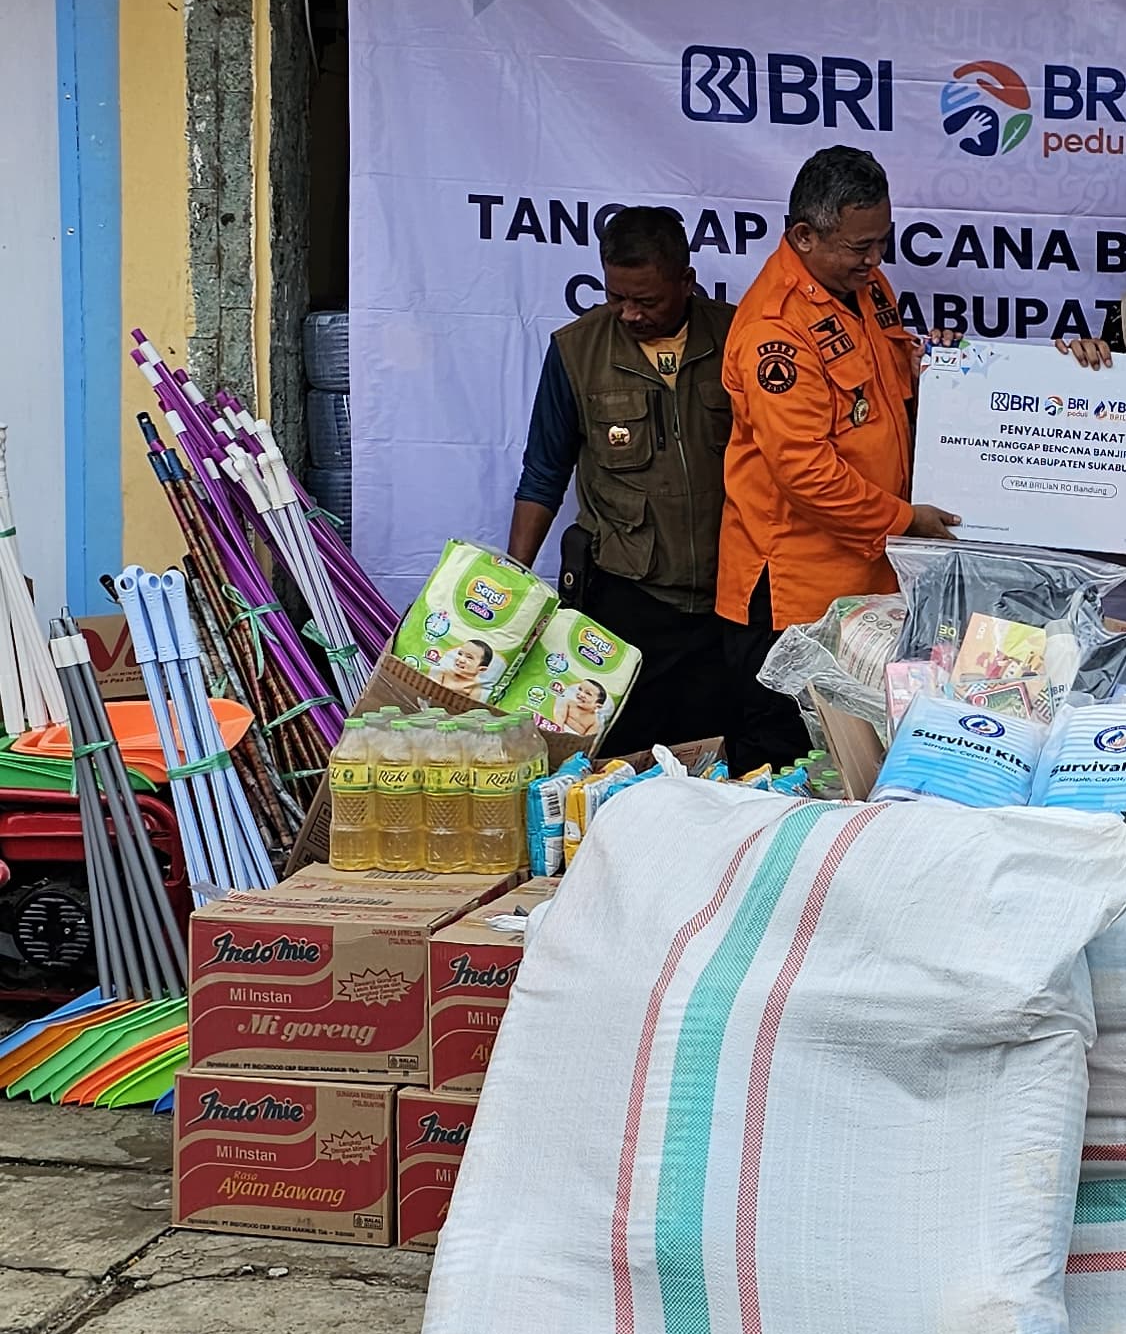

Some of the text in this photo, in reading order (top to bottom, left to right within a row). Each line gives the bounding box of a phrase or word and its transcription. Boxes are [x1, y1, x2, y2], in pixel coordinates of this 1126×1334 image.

[767, 53, 893, 132] BRI
[468, 194, 768, 255] TANAP
[1010, 395, 1040, 412] BRI
[1067, 398, 1089, 411] BRI
[1000, 424, 1126, 444] PENYALURAN ZAKAT
[940, 436, 989, 447] BANTUAN
[992, 440, 1041, 451] TANGGAP
[1042, 444, 1091, 456] BENCANA
[980, 453, 1024, 464] CISOLOK
[1026, 456, 1086, 469] KABUPATEN
[1010, 479, 1028, 487] YBM
[1060, 484, 1072, 492] RO
[1073, 485, 1107, 495] Bandung
[474, 580, 506, 605] Sensi
[585, 631, 612, 654] Sensi
[911, 729, 1032, 773] Survival Kits
[378, 770, 410, 784] Rizki
[199, 930, 321, 969] Indomie
[230, 988, 292, 1004] Mi Instan
[467, 1011, 484, 1025] Mi
[237, 1014, 377, 1047] Mi goreng
[184, 1087, 305, 1128] Indomie
[216, 1144, 277, 1162] Mi Instan
[233, 1170, 258, 1180] Rasa
[435, 1169, 452, 1182] Mi
[217, 1176, 346, 1207] Ayam Bawang
